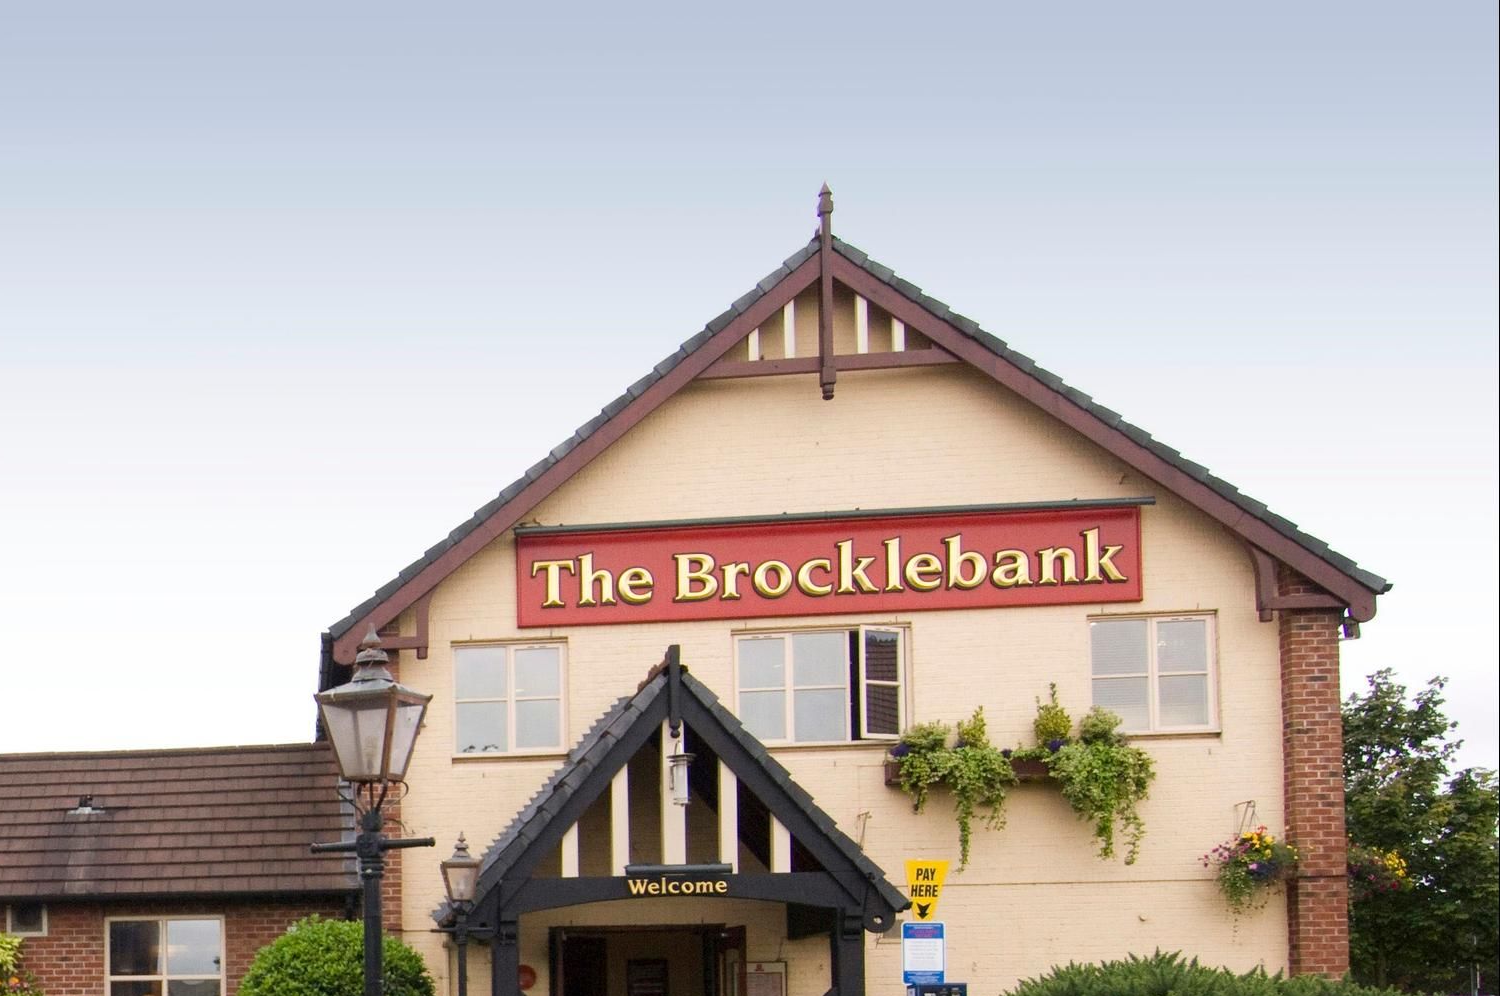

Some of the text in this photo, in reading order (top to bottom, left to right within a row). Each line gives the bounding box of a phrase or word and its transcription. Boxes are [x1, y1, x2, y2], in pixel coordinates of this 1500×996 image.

[531, 526, 1129, 609] The Brocklebank
[916, 867, 937, 882] PAY
[627, 876, 729, 896] Welcome
[910, 884, 939, 898] HERE
